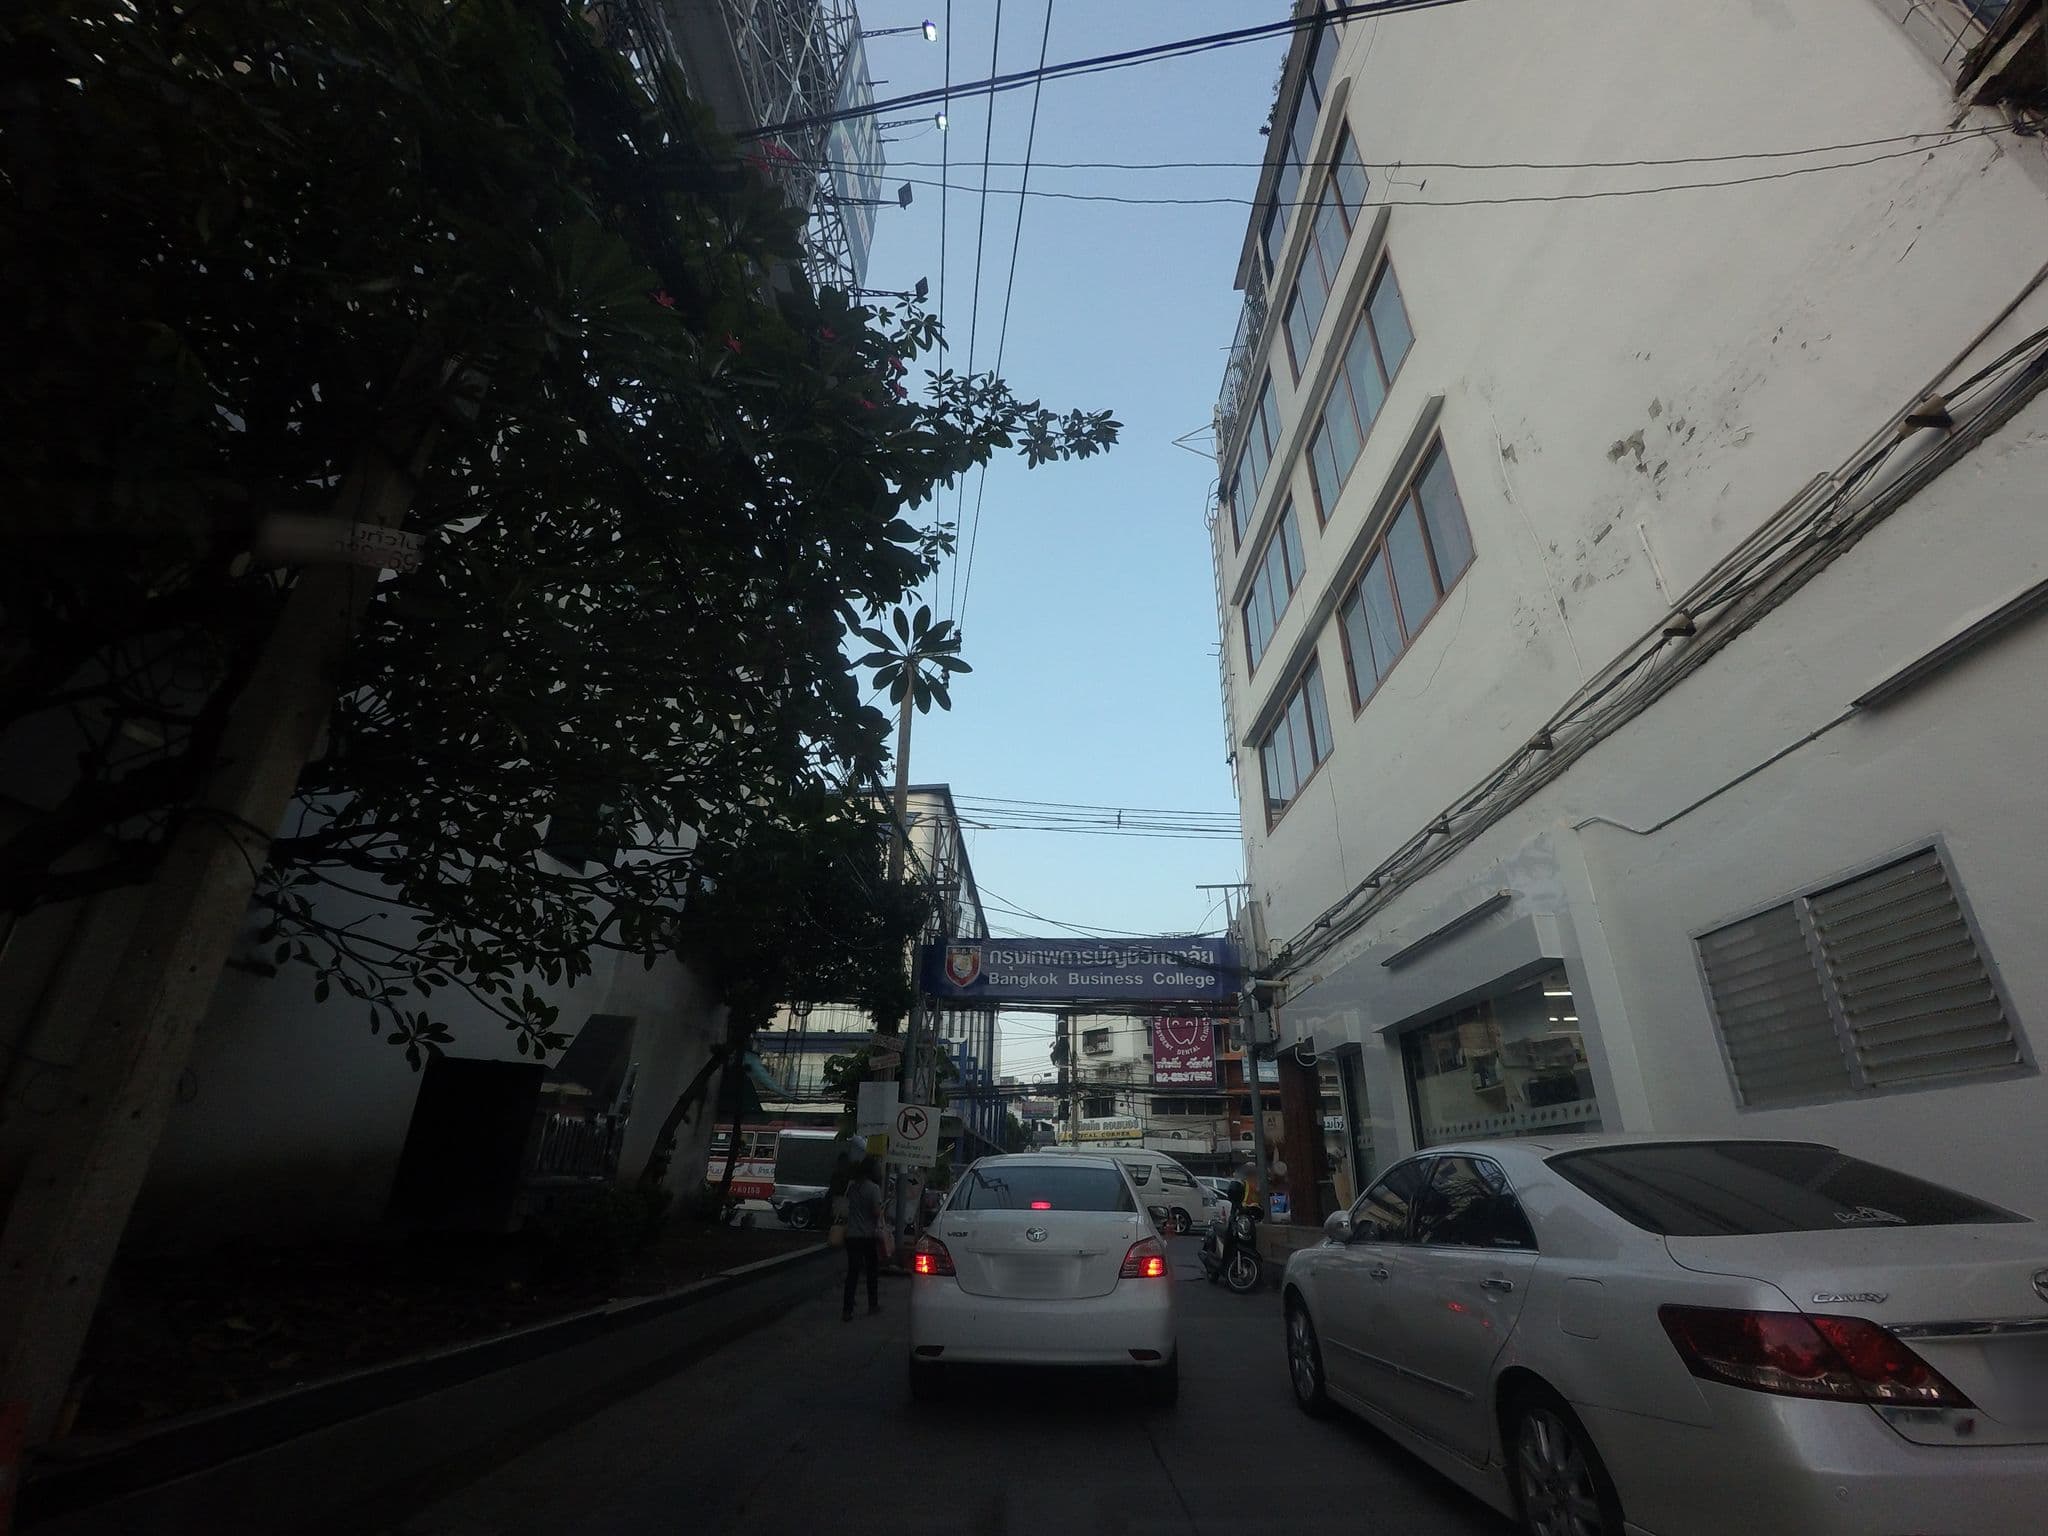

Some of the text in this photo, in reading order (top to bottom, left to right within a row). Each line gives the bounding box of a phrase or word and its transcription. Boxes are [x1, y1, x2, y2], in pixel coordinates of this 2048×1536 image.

[989, 972, 1216, 988] Bangkok Business College
[1176, 1045, 1201, 1056] DENTAL
